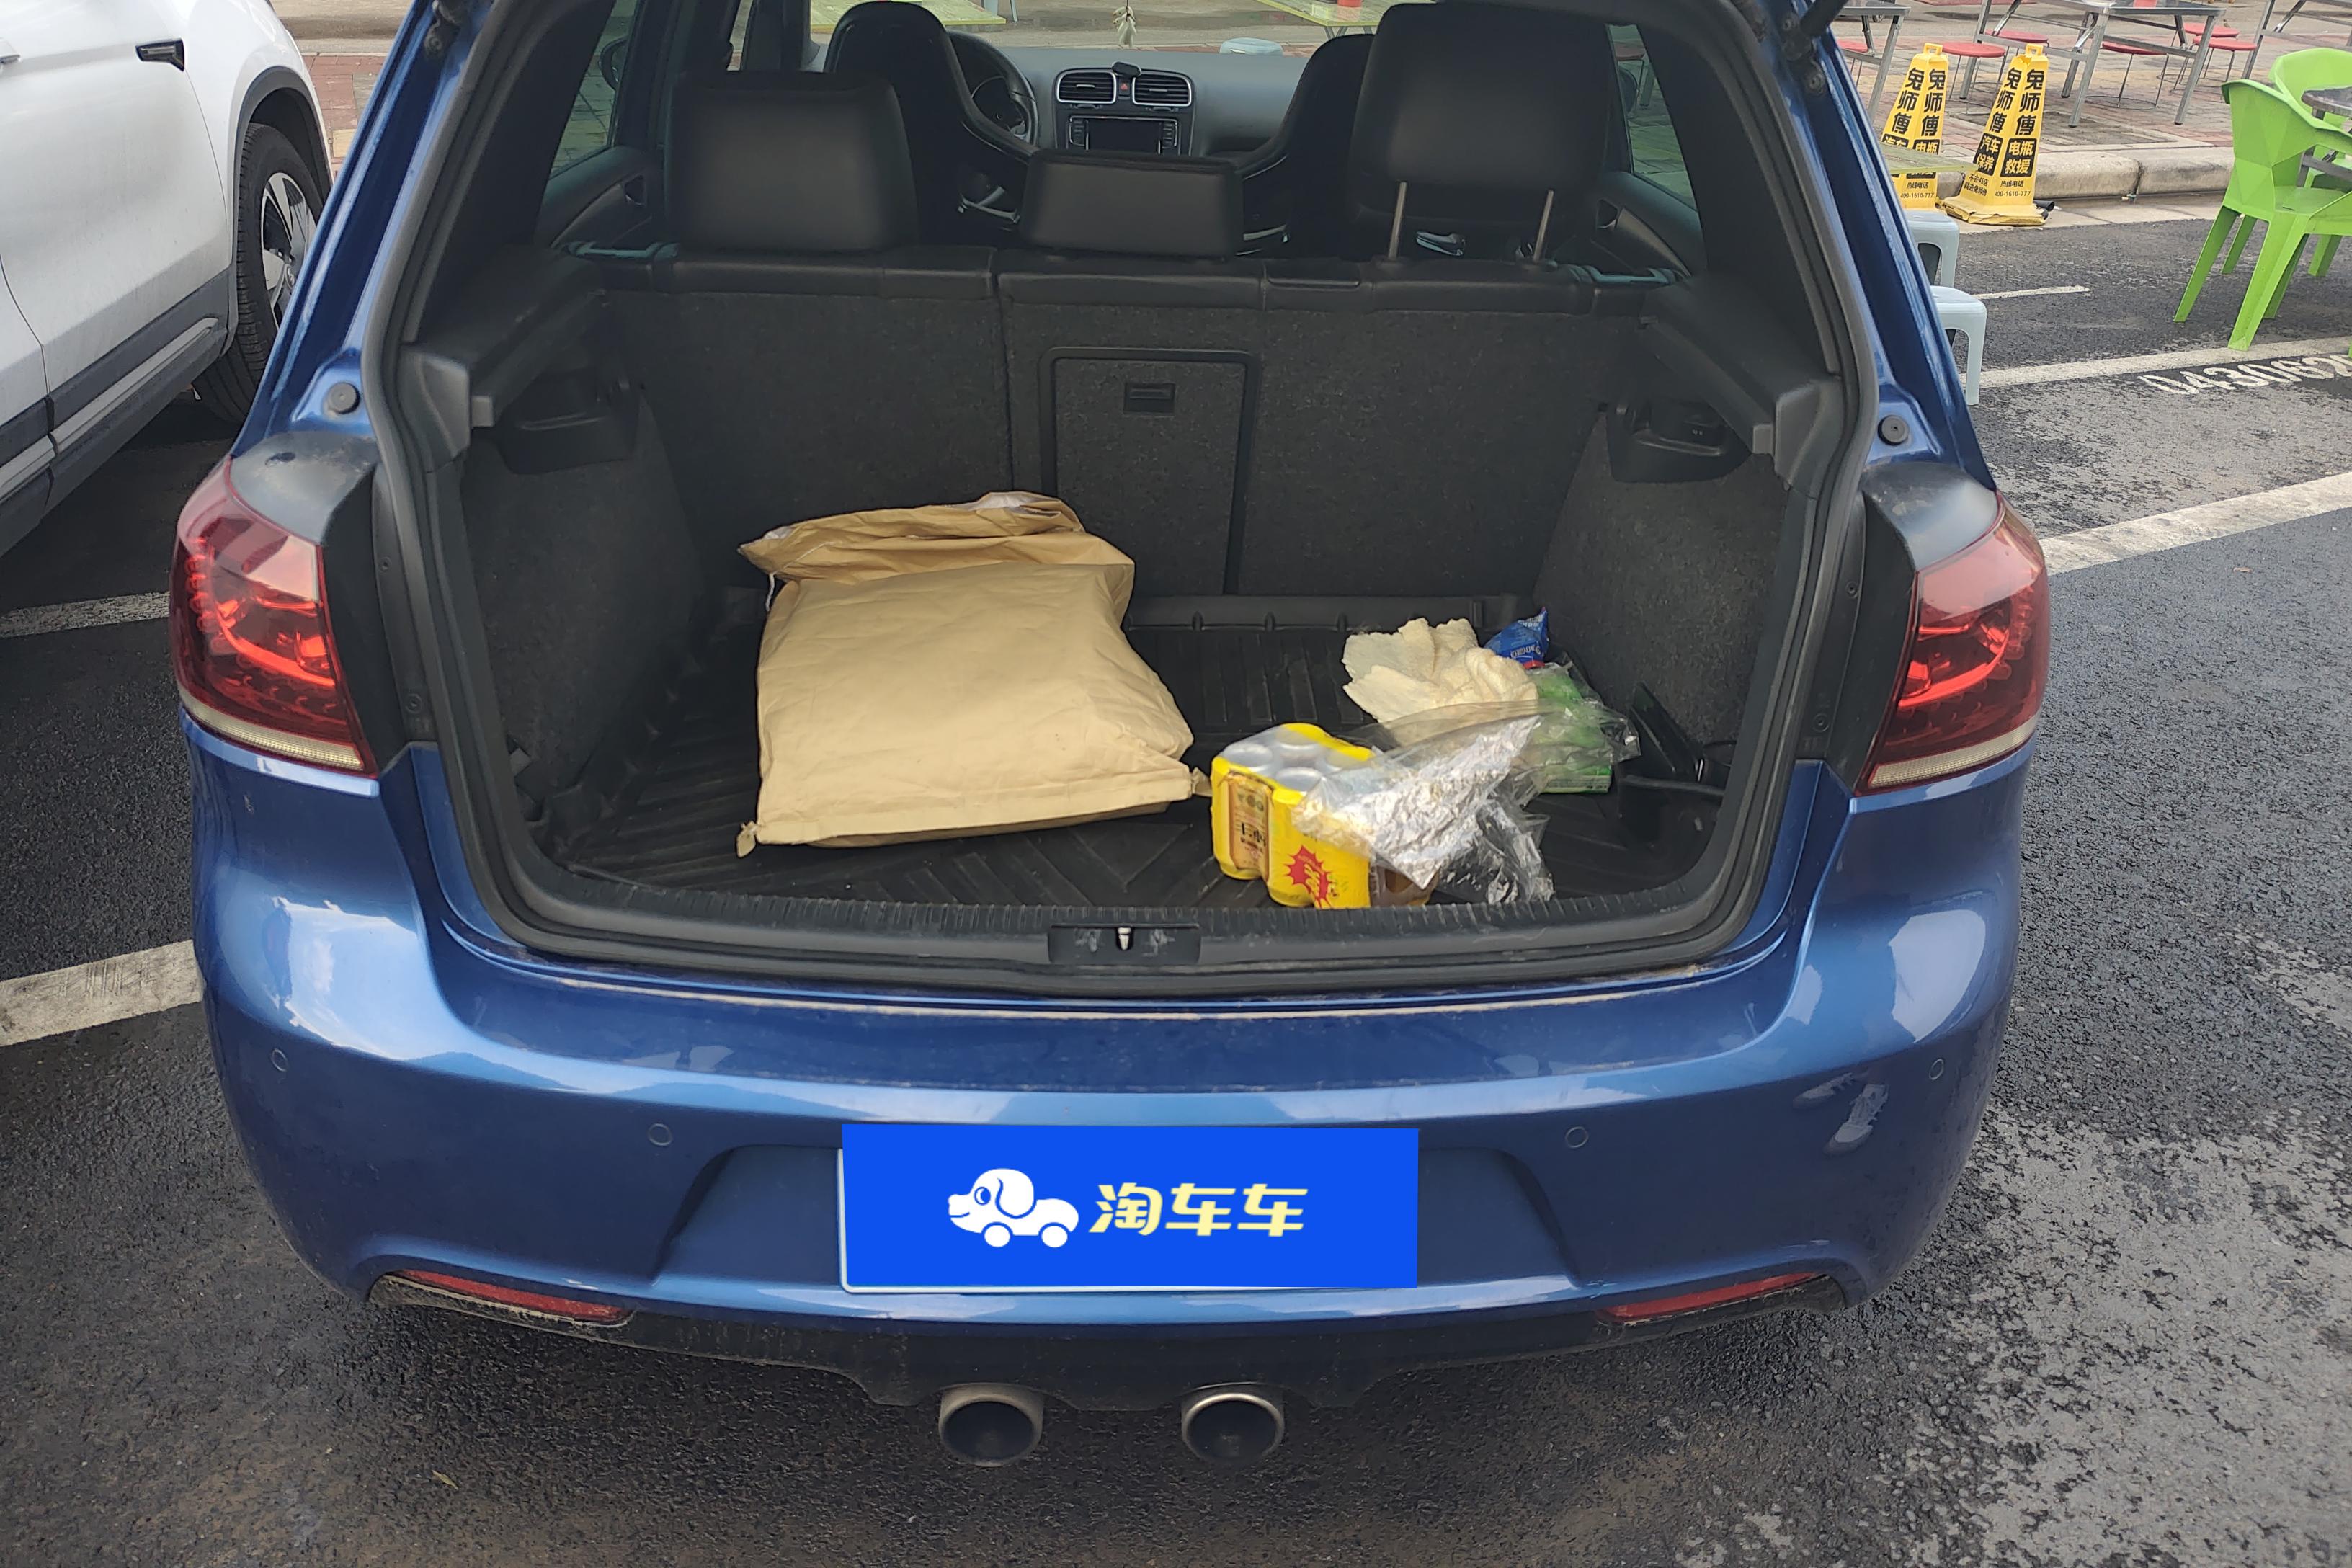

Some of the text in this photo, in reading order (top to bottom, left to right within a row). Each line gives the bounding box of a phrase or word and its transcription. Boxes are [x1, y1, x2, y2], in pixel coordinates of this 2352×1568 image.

[1979, 135, 2001, 154] 汽车
[2009, 141, 2034, 156] 电瓶
[1977, 153, 1995, 172] 保养
[2005, 159, 2031, 174] 救援
